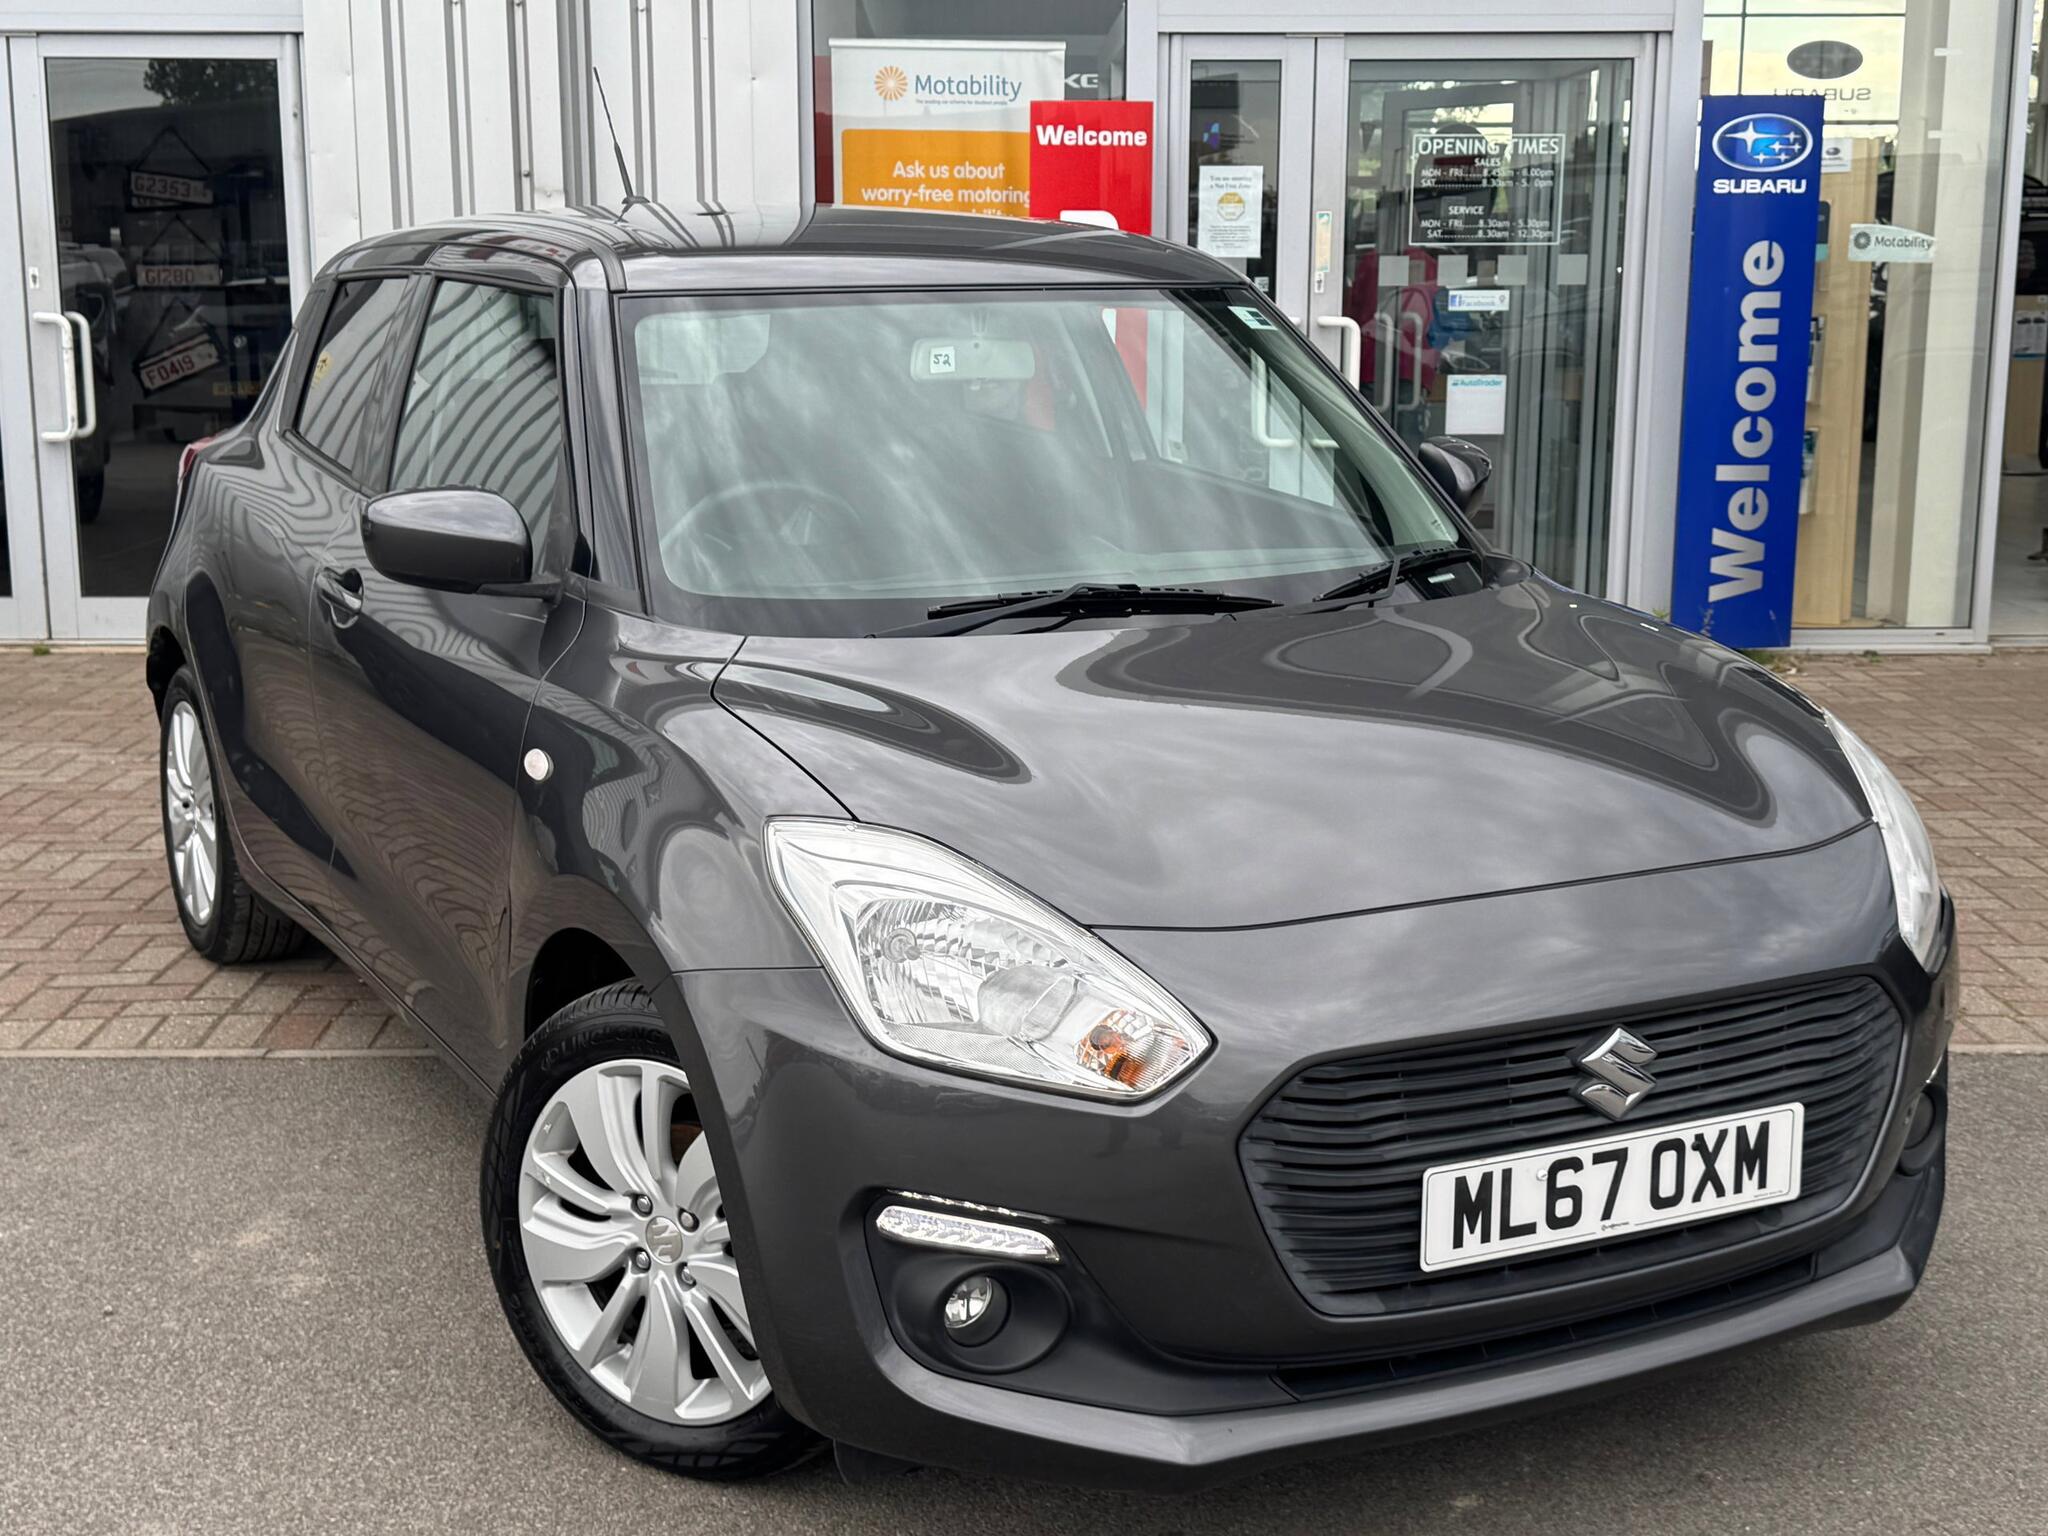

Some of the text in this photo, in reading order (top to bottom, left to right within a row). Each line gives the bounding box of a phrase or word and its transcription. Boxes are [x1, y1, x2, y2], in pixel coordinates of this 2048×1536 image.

[915, 74, 1022, 102] Motability
[1036, 124, 1147, 147] Welcome
[1418, 138, 1559, 155] OPENING TIMES
[892, 160, 1005, 180] Ask us about
[1474, 157, 1501, 167] SALES
[1420, 169, 1441, 177] MON
[1713, 178, 1806, 194] SUBARU
[861, 184, 1031, 206] worry-free motoring
[1448, 205, 1485, 215] SERVICE
[1420, 219, 1441, 227] MON
[1874, 236, 1932, 250] Motability
[1708, 239, 1785, 602] Welcome
[1453, 1146, 1630, 1250] ML67
